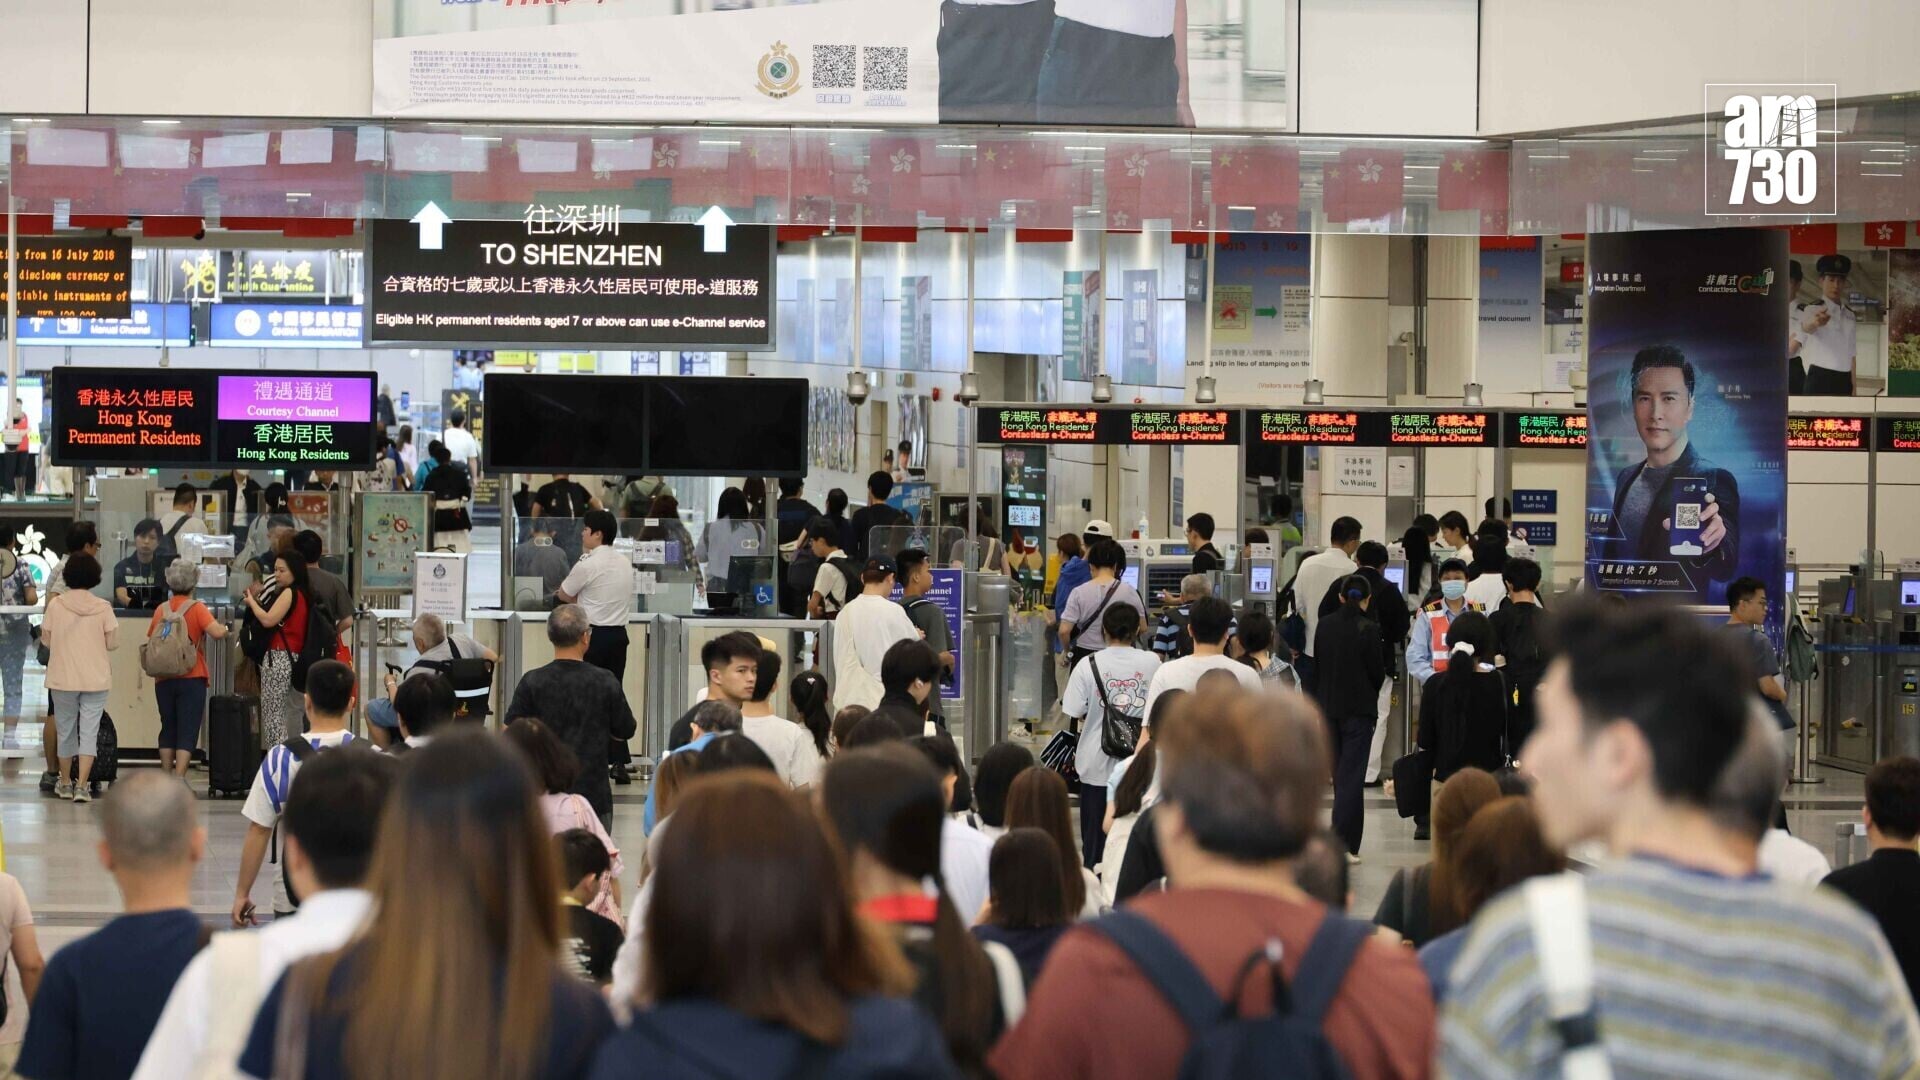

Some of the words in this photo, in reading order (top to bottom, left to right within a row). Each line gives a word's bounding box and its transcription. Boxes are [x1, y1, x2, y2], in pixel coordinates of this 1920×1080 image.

[523, 204, 620, 236] 往深圳
[25, 249, 46, 260] from
[52, 249, 62, 260] 16
[67, 249, 88, 261] July
[93, 250, 114, 260] 2018
[480, 244, 516, 265] TO
[524, 244, 662, 266] SHENZHEN
[20, 269, 61, 280] disclose
[66, 272, 109, 282] currency
[114, 272, 124, 280] or
[54, 290, 111, 301] instruments
[116, 290, 127, 301] of
[376, 314, 413, 327] Eligible
[416, 315, 434, 325] HK
[436, 316, 491, 327] permanent
[494, 315, 541, 326] residents
[544, 315, 569, 328] aged
[573, 316, 579, 325] 7
[582, 318, 593, 326] or
[595, 317, 626, 327] above
[629, 319, 648, 327] can
[651, 319, 669, 327] use
[673, 317, 726, 328] e-Channel
[729, 318, 766, 328] service
[254, 382, 333, 401] 禮遇通道
[77, 389, 194, 407] 香港永久性居民
[247, 405, 293, 419] Courtesy
[296, 406, 338, 417] Channel
[1000, 411, 1040, 422] 香港居民
[98, 410, 133, 427] Hong
[138, 411, 172, 427] Kong
[1131, 413, 1170, 423] 香港居民
[1261, 413, 1301, 424] 香港居民
[1391, 415, 1430, 426] 香港居民
[1519, 416, 1558, 426] 香港居民
[1001, 422, 1024, 431] Hong
[1026, 422, 1047, 431] Kong
[1050, 422, 1089, 431] Residents
[1132, 424, 1154, 433] Hong
[1157, 424, 1177, 433] Kong
[1262, 424, 1284, 433] Hong
[1286, 424, 1307, 433] Kong
[1310, 425, 1349, 433] Residents
[1392, 426, 1414, 435] Hong
[1416, 426, 1437, 435] Kong
[1439, 426, 1478, 434] Residents
[1520, 427, 1542, 436] Hong
[1545, 427, 1565, 436] Kong
[68, 430, 135, 445] Permanent
[140, 430, 201, 446] Residents
[254, 424, 333, 444] 香港居民
[1001, 430, 1050, 438] Contactless
[1051, 430, 1094, 439] e-Channel
[1132, 431, 1180, 440] Contactless
[1182, 431, 1225, 440] e-Channel
[1262, 431, 1310, 440] Contactless
[1311, 432, 1355, 441] e-Channel
[1392, 434, 1439, 442] Contactless
[1441, 434, 1483, 442] e-Channel
[1520, 434, 1567, 443] Contactless
[1793, 430, 1814, 439] Kong
[1894, 432, 1915, 440] Hong
[1818, 439, 1859, 447] e-Channel
[237, 448, 265, 461] Hong
[269, 448, 296, 461] Kong
[300, 448, 349, 460] Residents
[1351, 479, 1377, 487] Waiting
